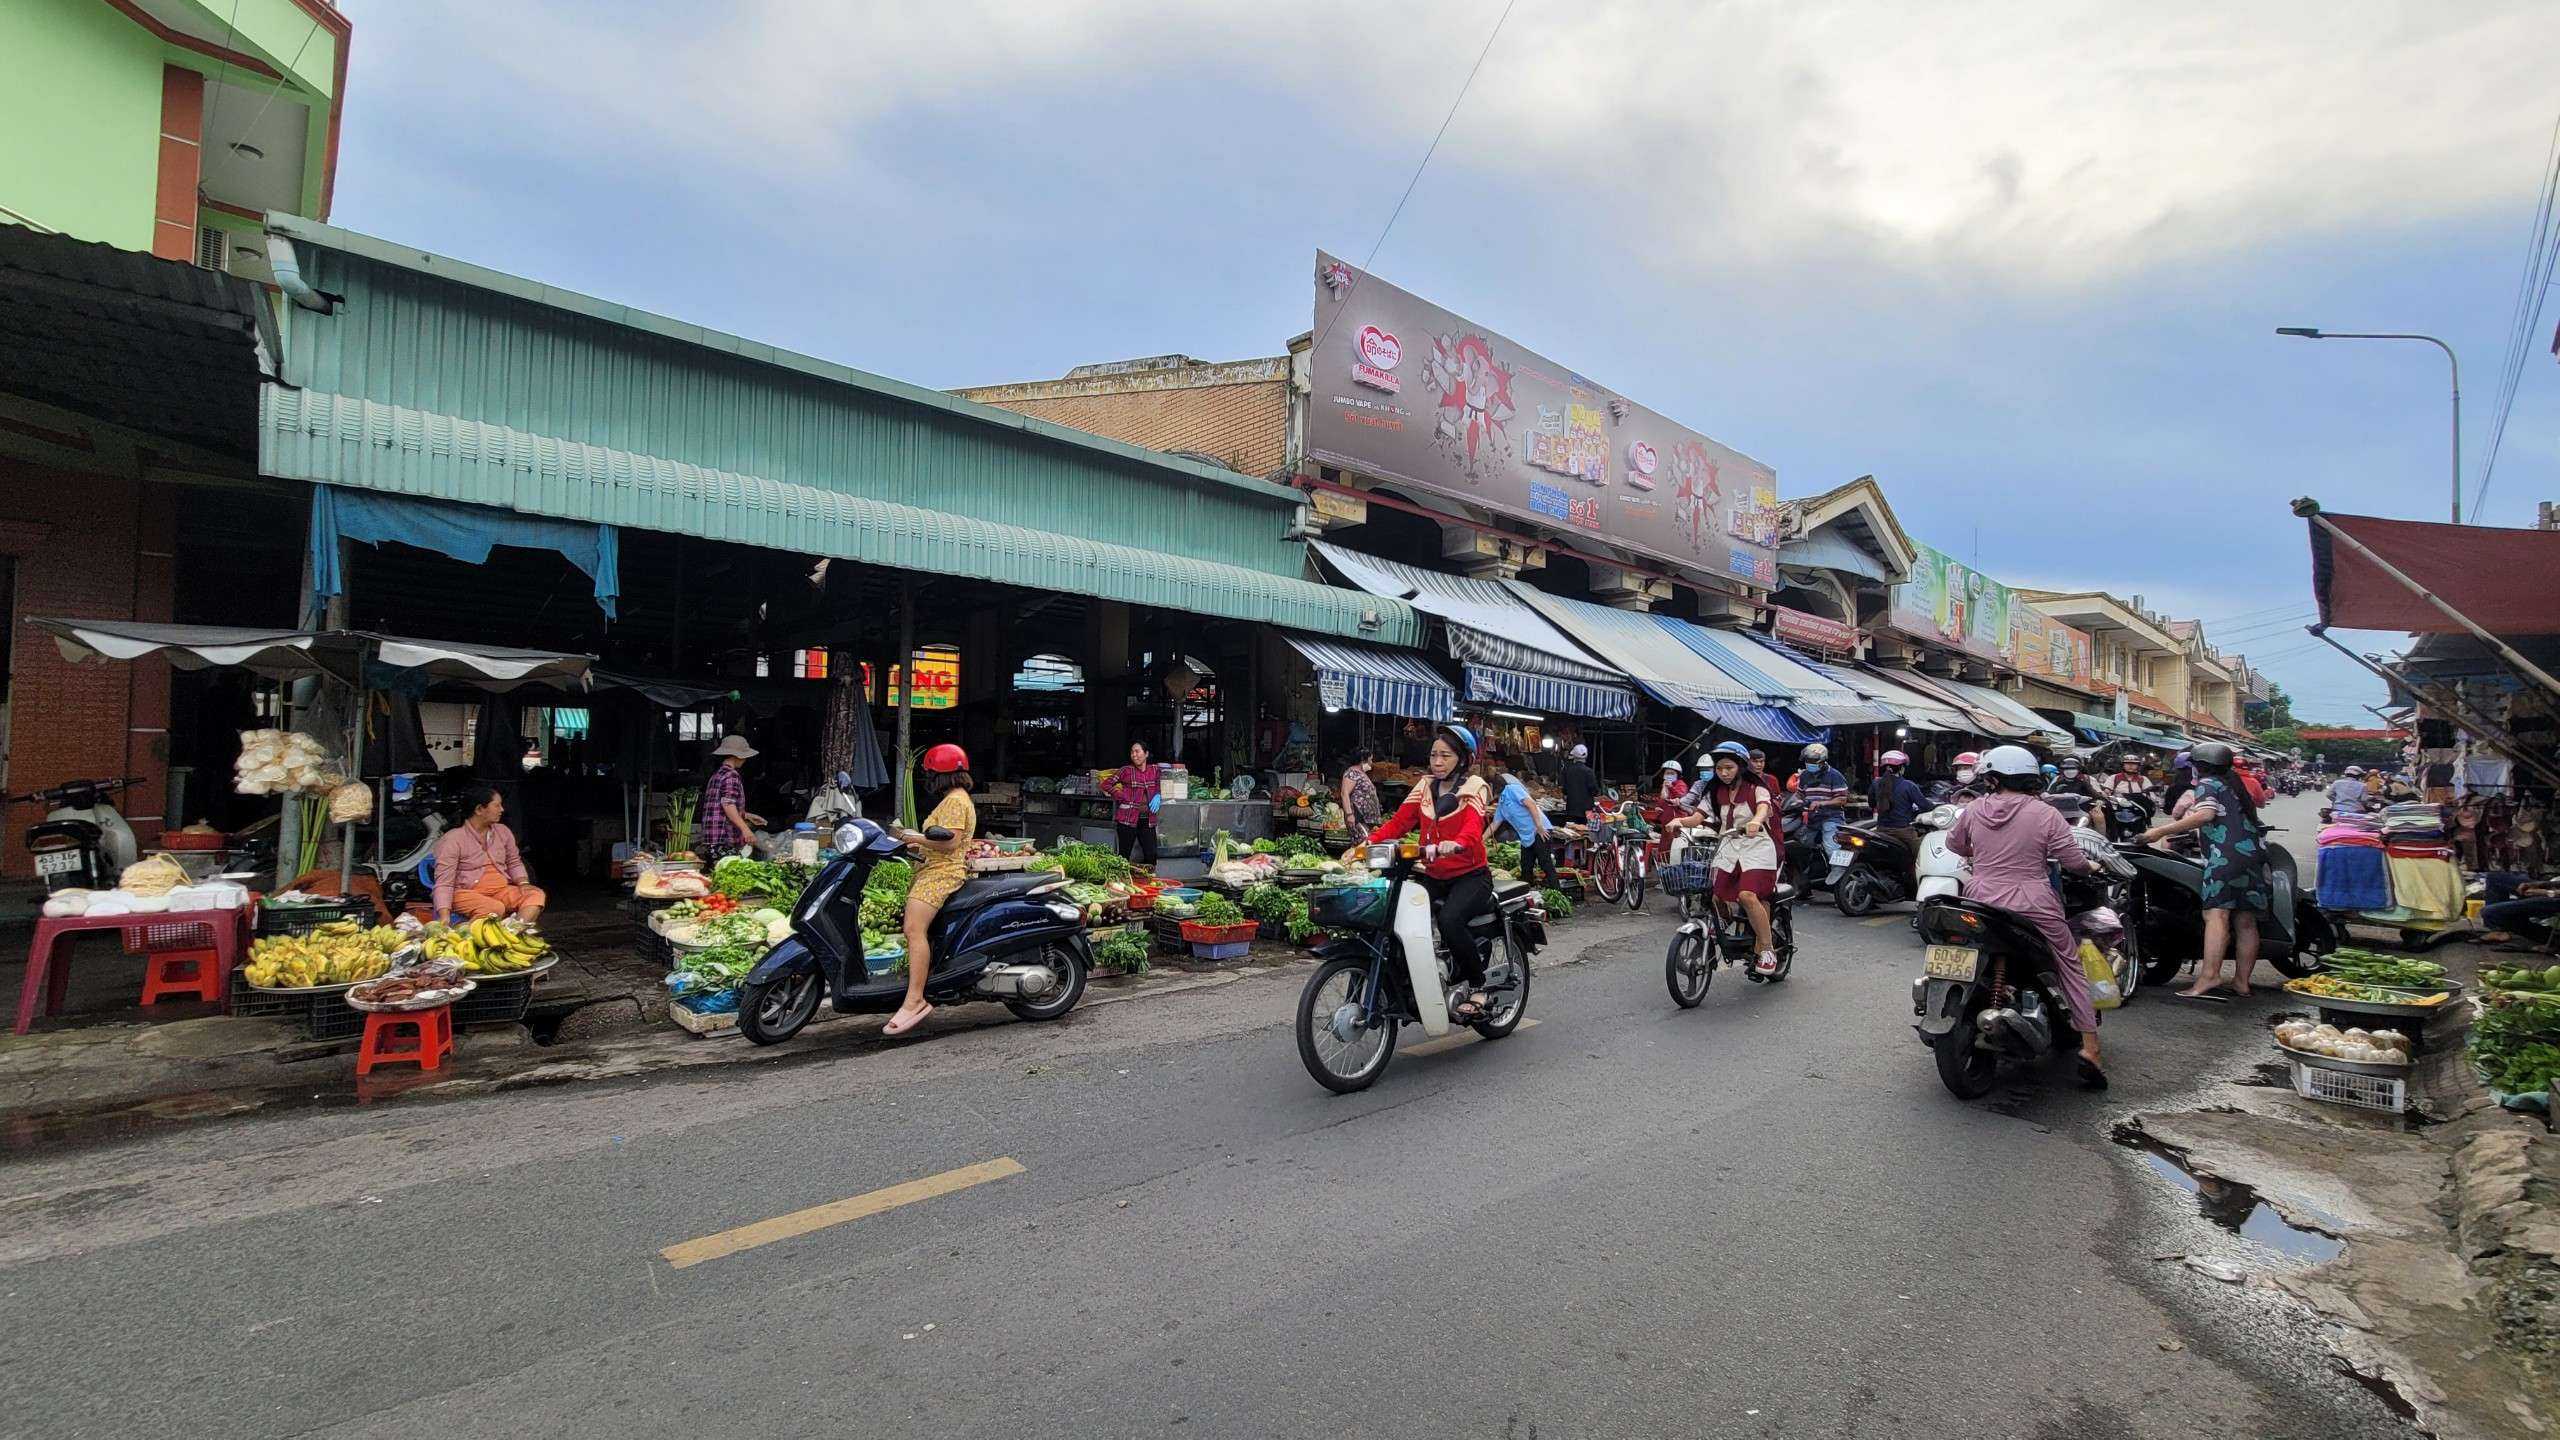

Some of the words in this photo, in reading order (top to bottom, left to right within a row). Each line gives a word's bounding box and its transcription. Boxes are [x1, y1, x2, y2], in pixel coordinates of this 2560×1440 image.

[1360, 364, 1400, 385] FUMAKILLA
[1333, 395, 1355, 406] JUMBO
[1356, 399, 1372, 409] VAPE
